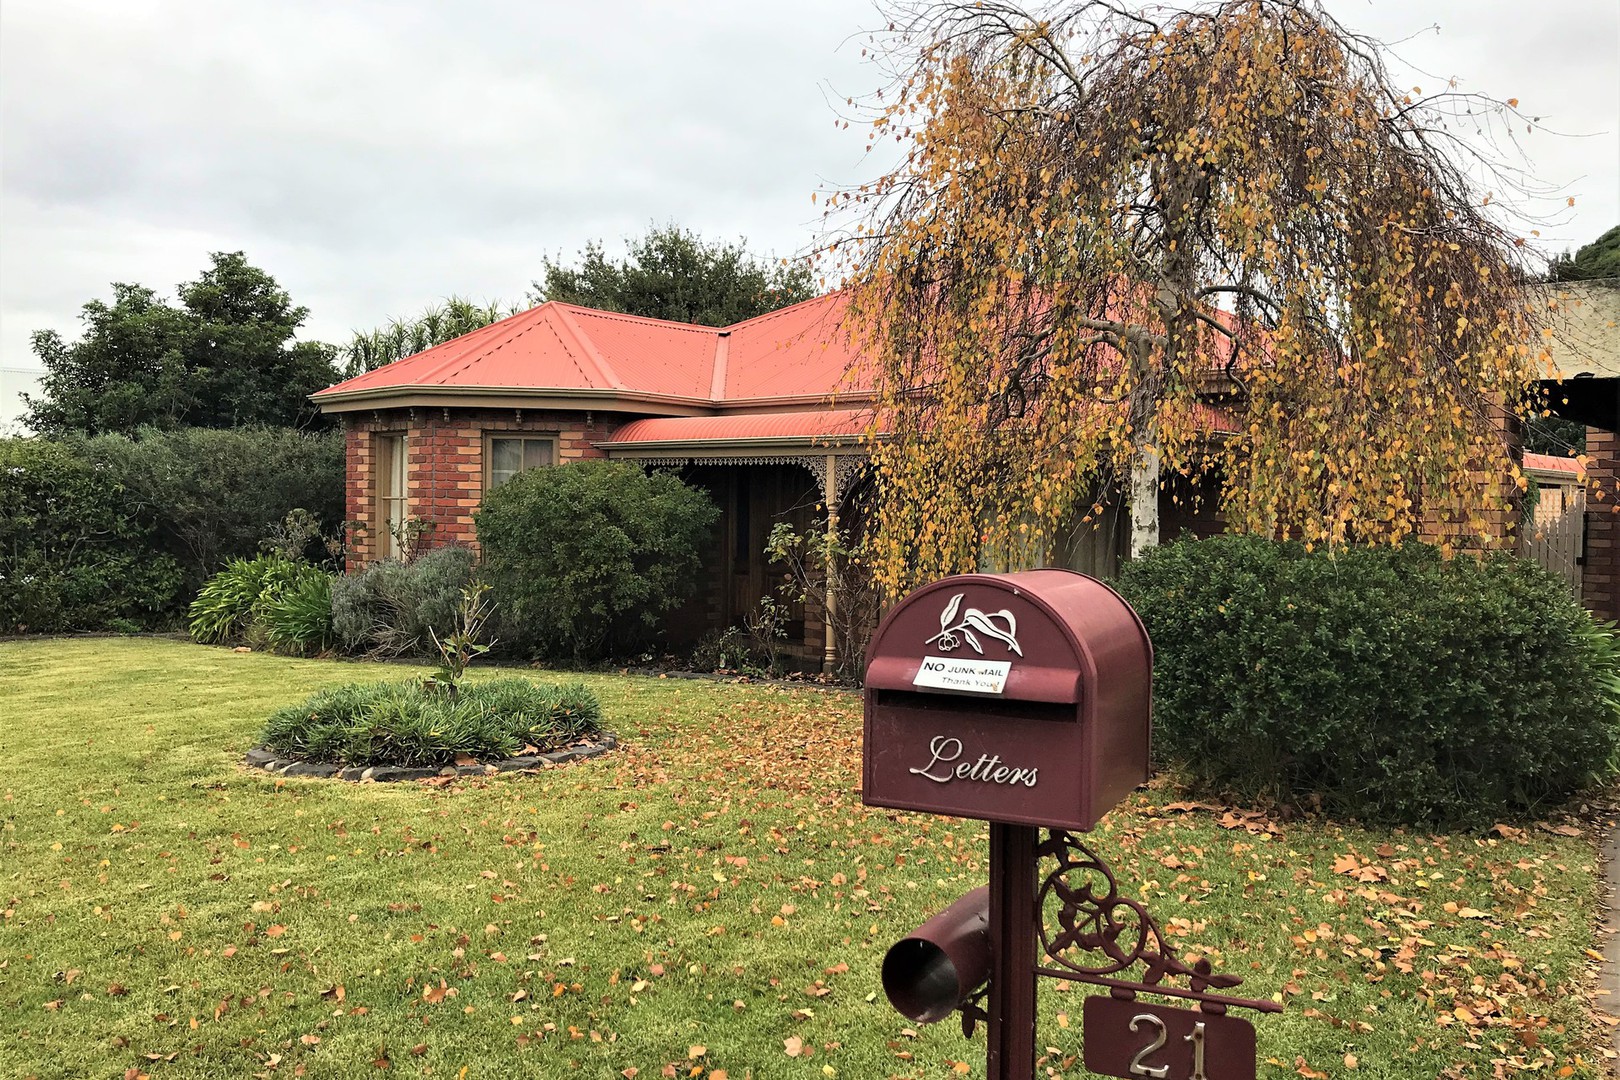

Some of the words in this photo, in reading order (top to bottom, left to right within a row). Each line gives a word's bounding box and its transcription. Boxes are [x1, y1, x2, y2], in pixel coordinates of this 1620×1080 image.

[924, 662, 945, 672] NO
[948, 666, 976, 675] JUNK
[942, 676, 971, 686] Thank
[909, 735, 1038, 787] Letters
[1128, 1013, 1207, 1080] 21
